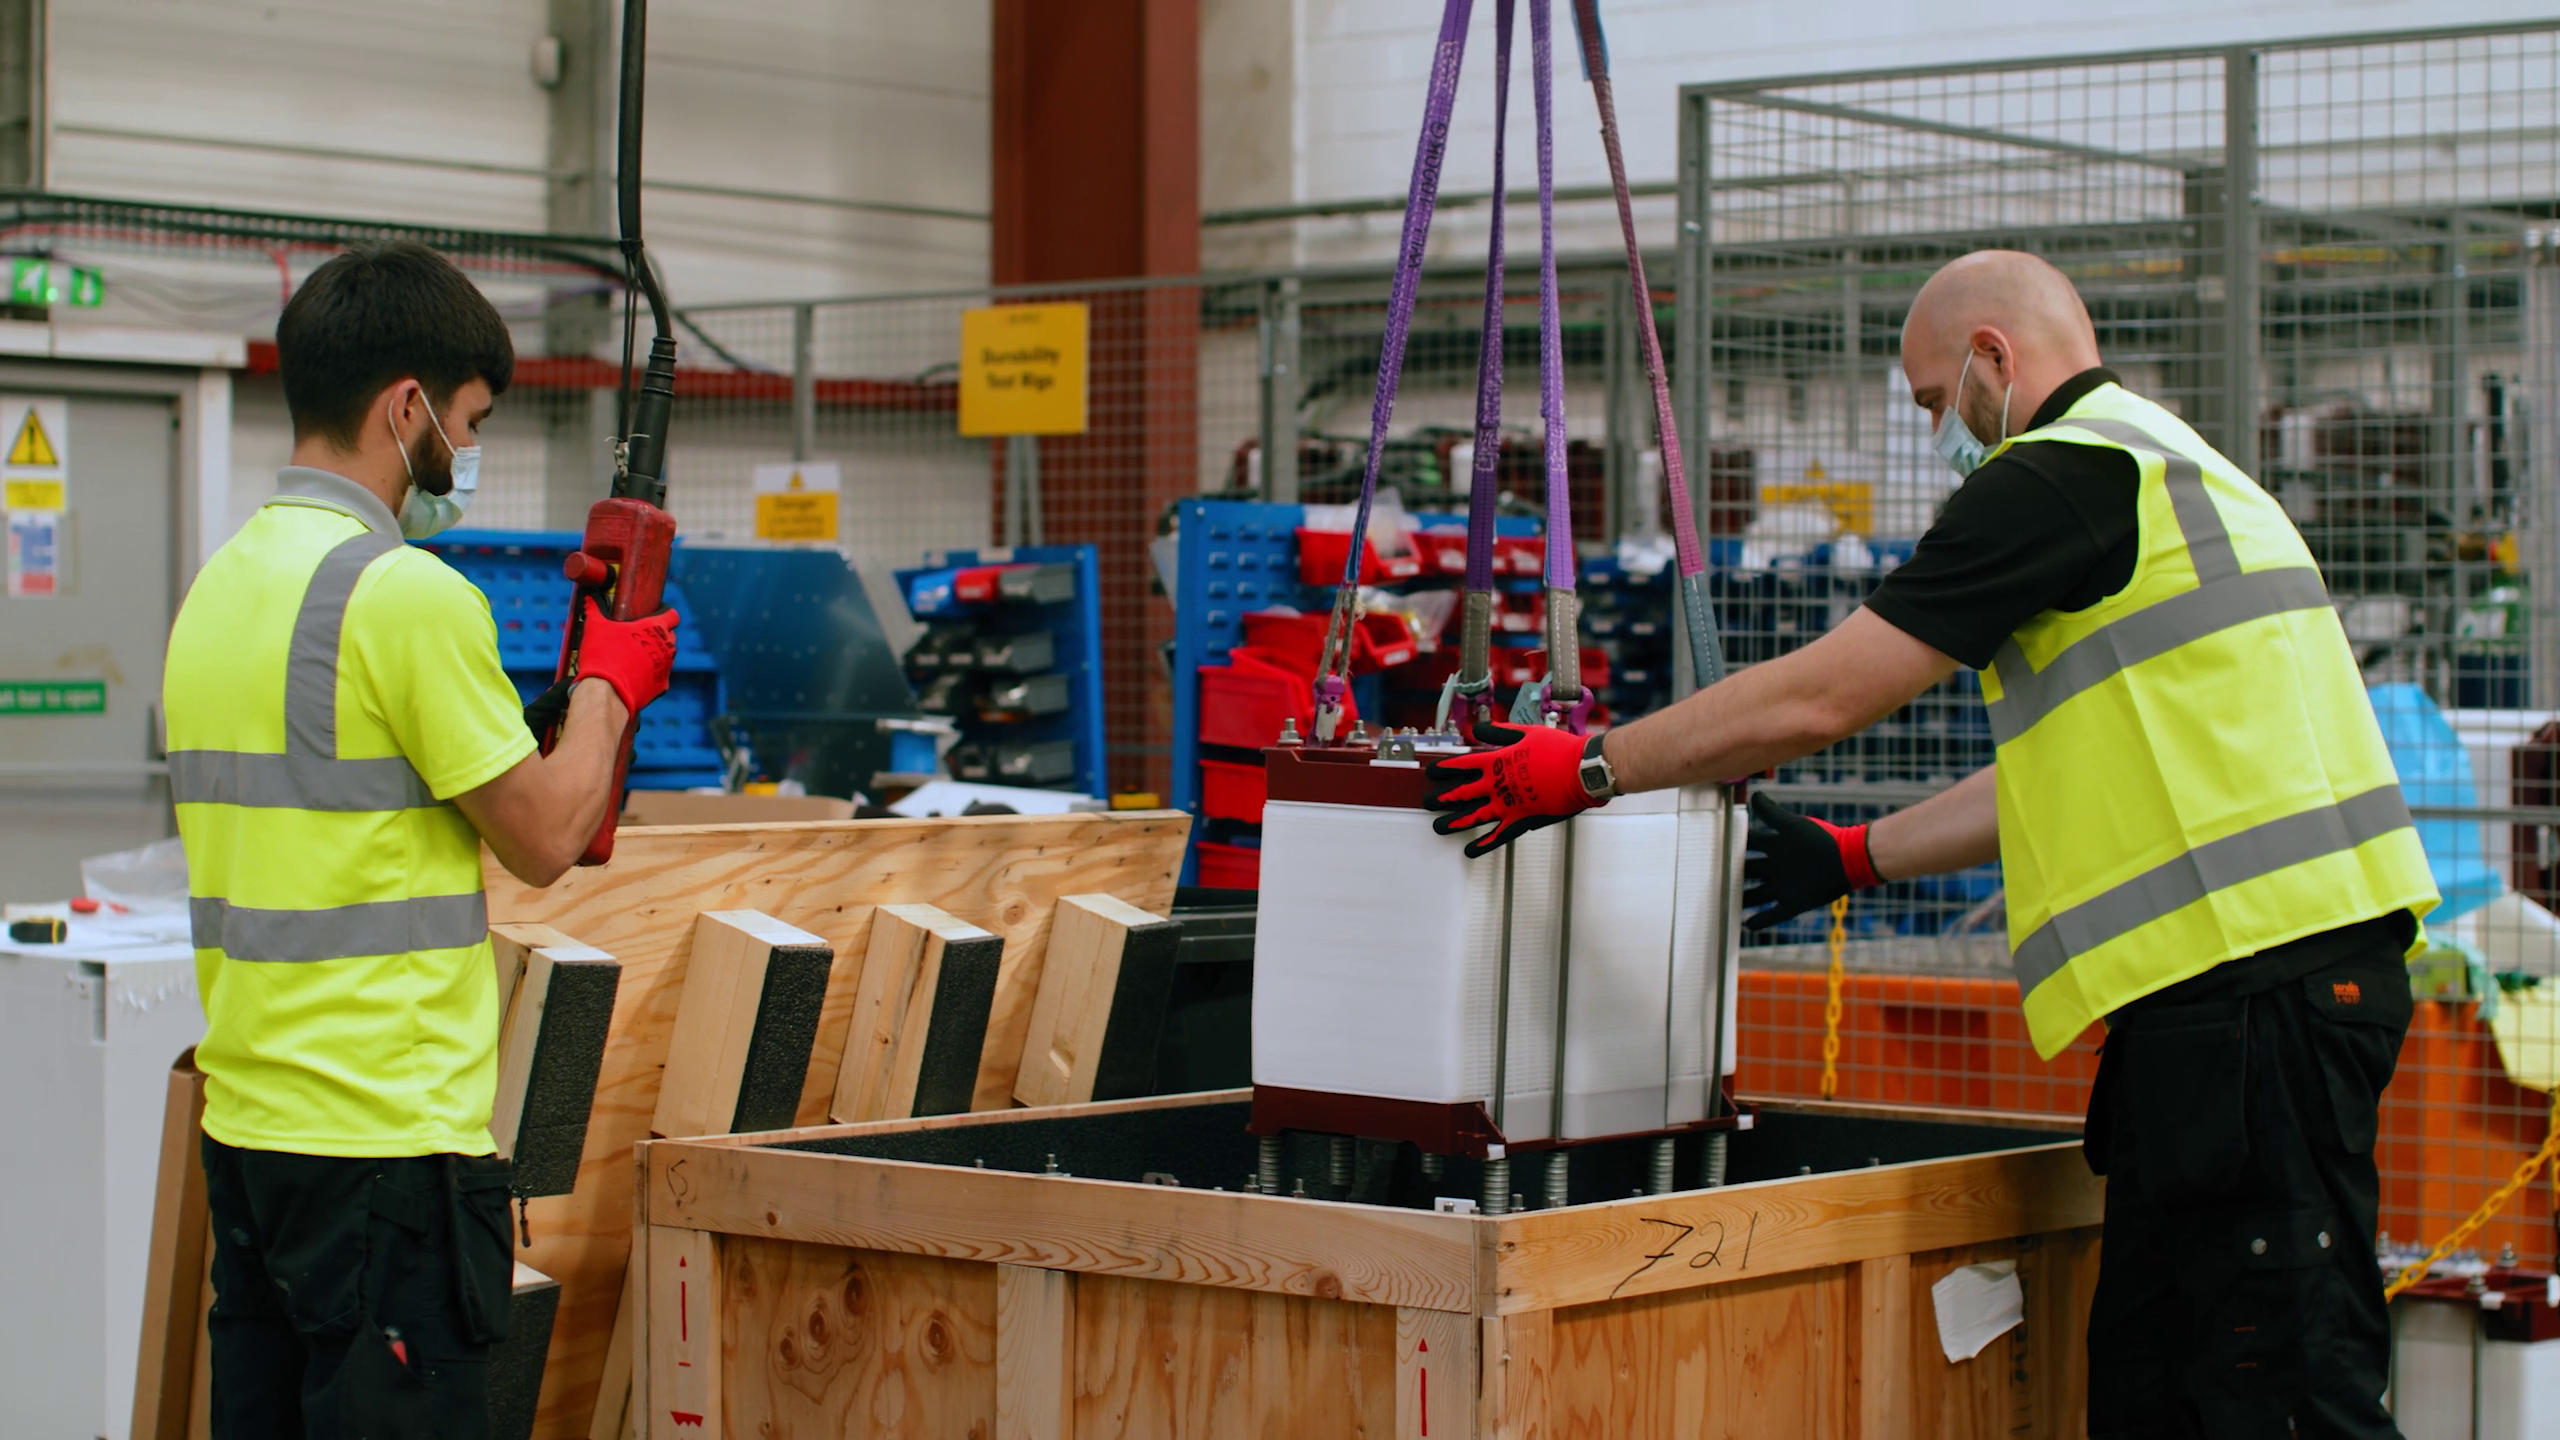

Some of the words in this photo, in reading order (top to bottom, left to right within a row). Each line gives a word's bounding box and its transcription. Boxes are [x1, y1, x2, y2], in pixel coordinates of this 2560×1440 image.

[1419, 121, 1448, 204] 1000KG
[981, 347, 1058, 367] Durability
[986, 372, 1015, 388] Test
[1021, 372, 1054, 393] Rigs
[1610, 1211, 1758, 1300] 721
